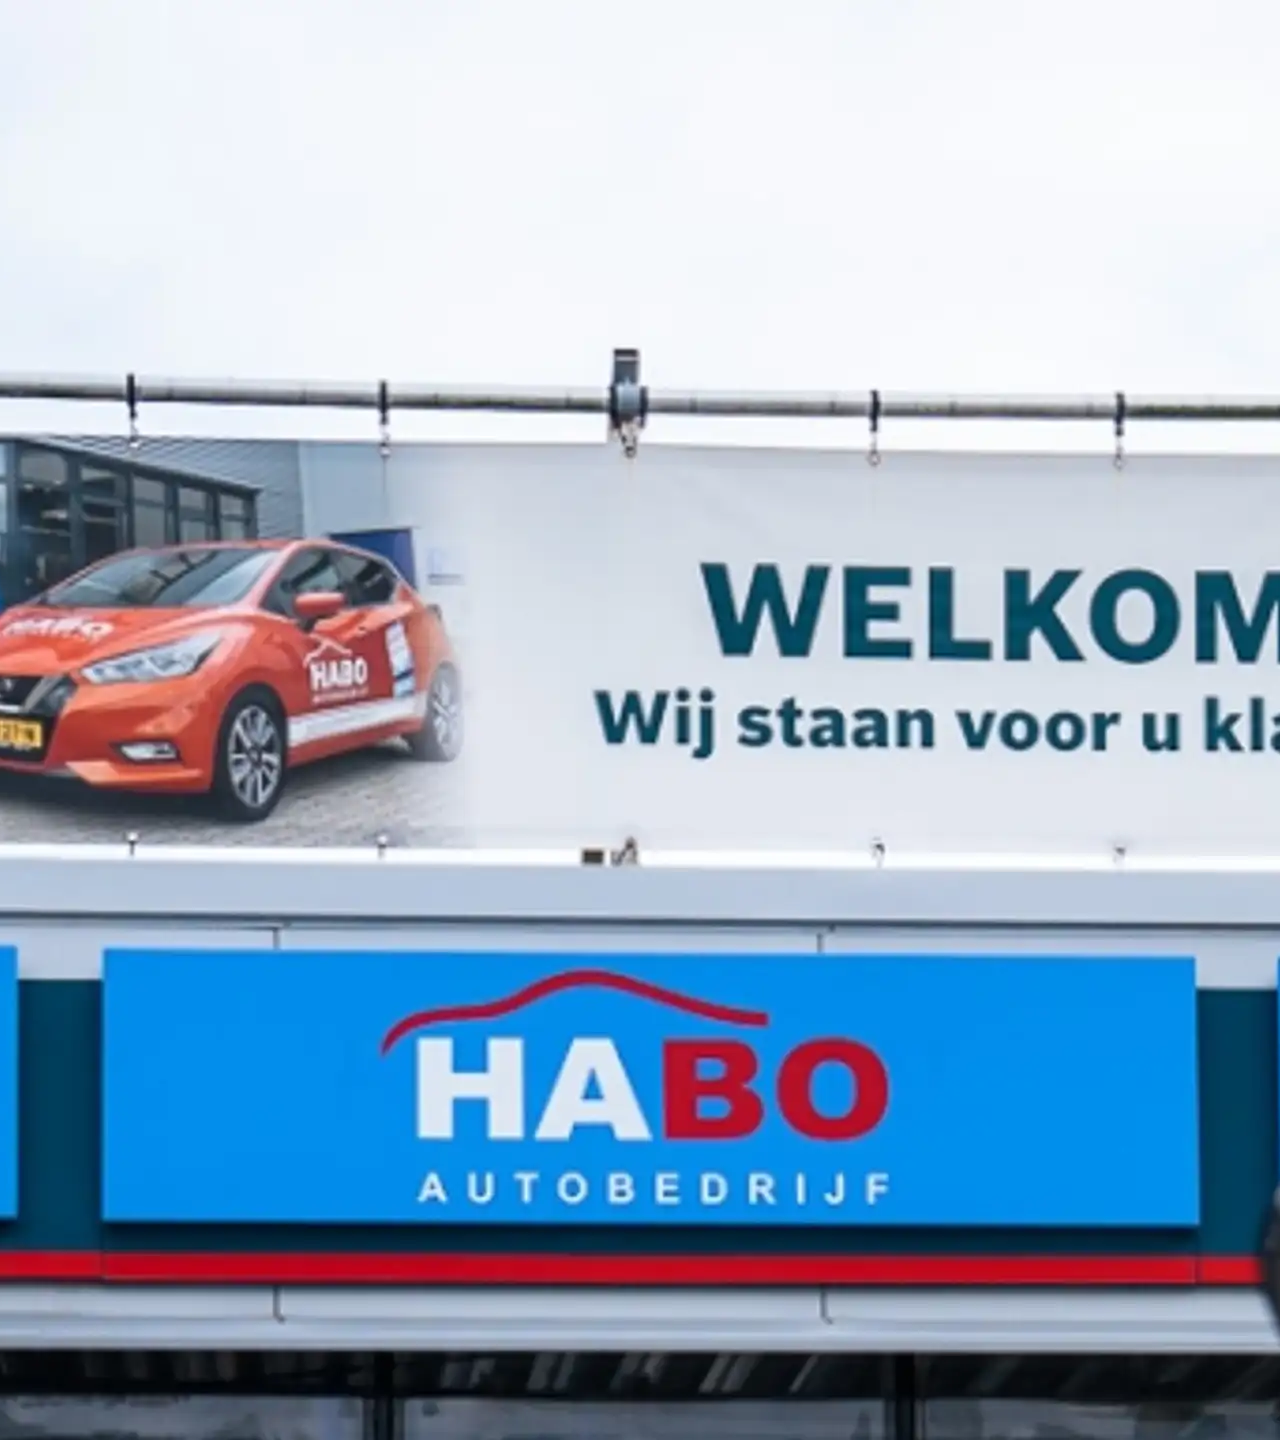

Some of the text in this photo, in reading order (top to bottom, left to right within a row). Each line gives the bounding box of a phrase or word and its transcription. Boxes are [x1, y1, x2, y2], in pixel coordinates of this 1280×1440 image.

[310, 657, 367, 691] HABO
[595, 688, 715, 760] Wij
[738, 698, 935, 750] staan
[956, 709, 1121, 752] voor
[1142, 712, 1181, 752] u
[417, 1037, 890, 1141] HABO
[418, 1172, 890, 1206] AUTOBEDRIJF
